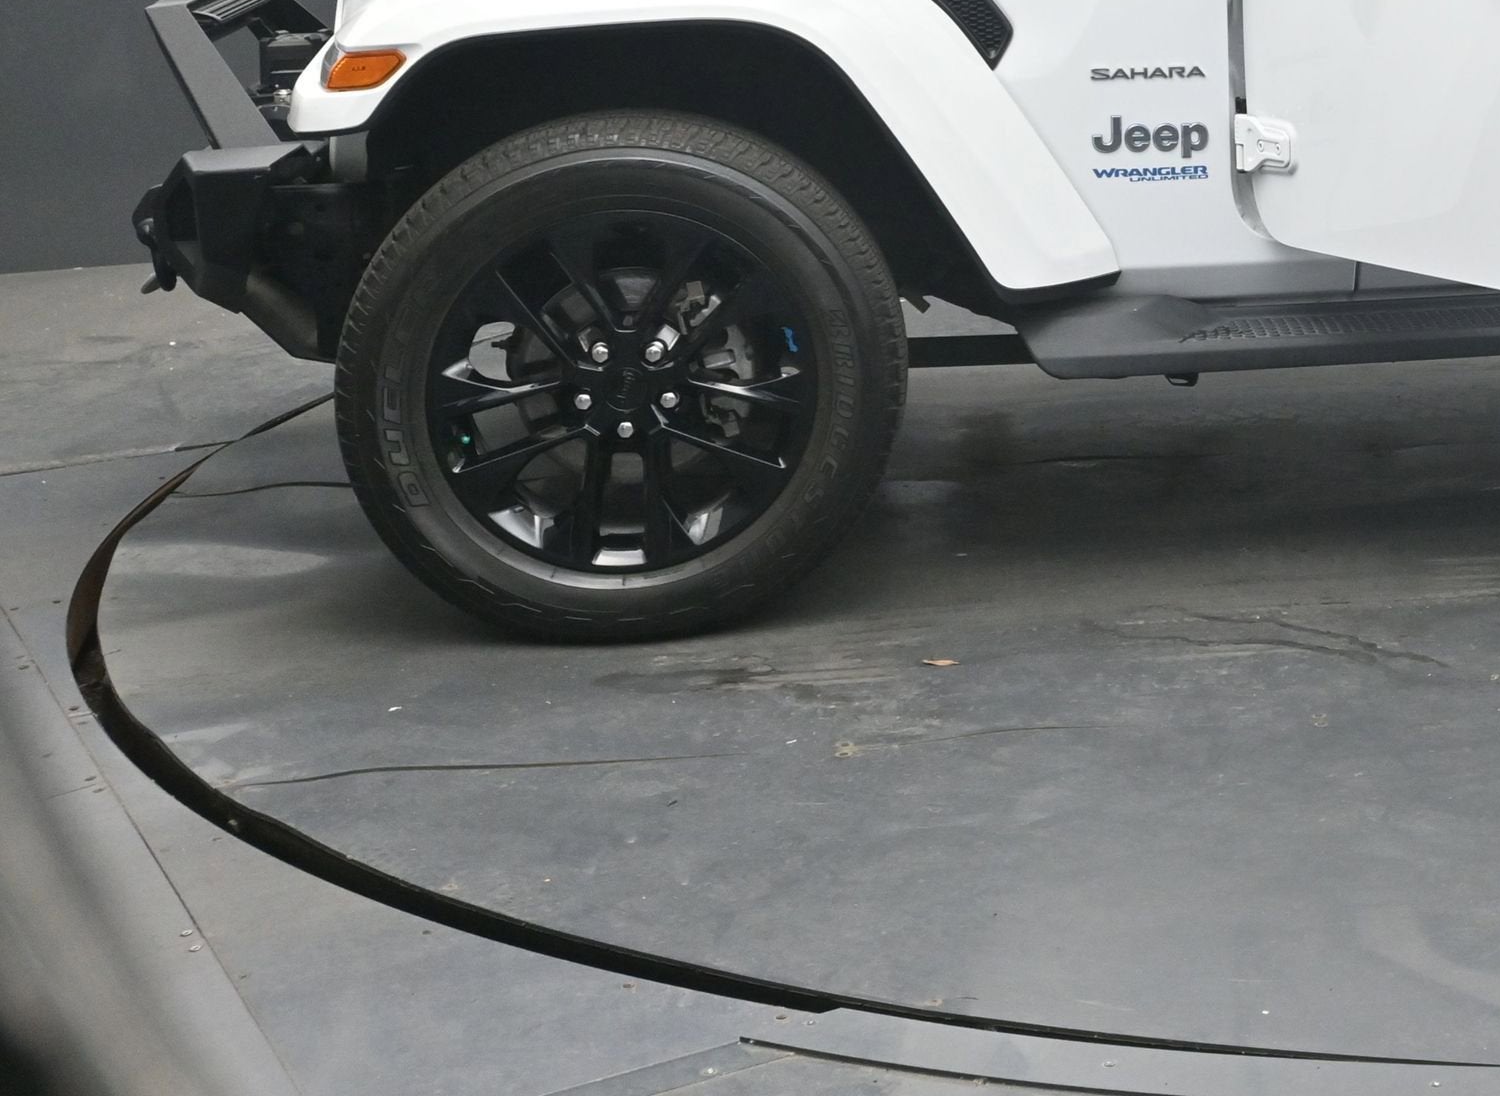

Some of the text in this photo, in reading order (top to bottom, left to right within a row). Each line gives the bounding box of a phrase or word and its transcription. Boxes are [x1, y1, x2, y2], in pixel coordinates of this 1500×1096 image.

[1090, 65, 1206, 81] SAHARA
[1092, 114, 1209, 159] Jeep
[1092, 164, 1209, 179] WRANGLER
[1129, 174, 1209, 183] UNLIMITED
